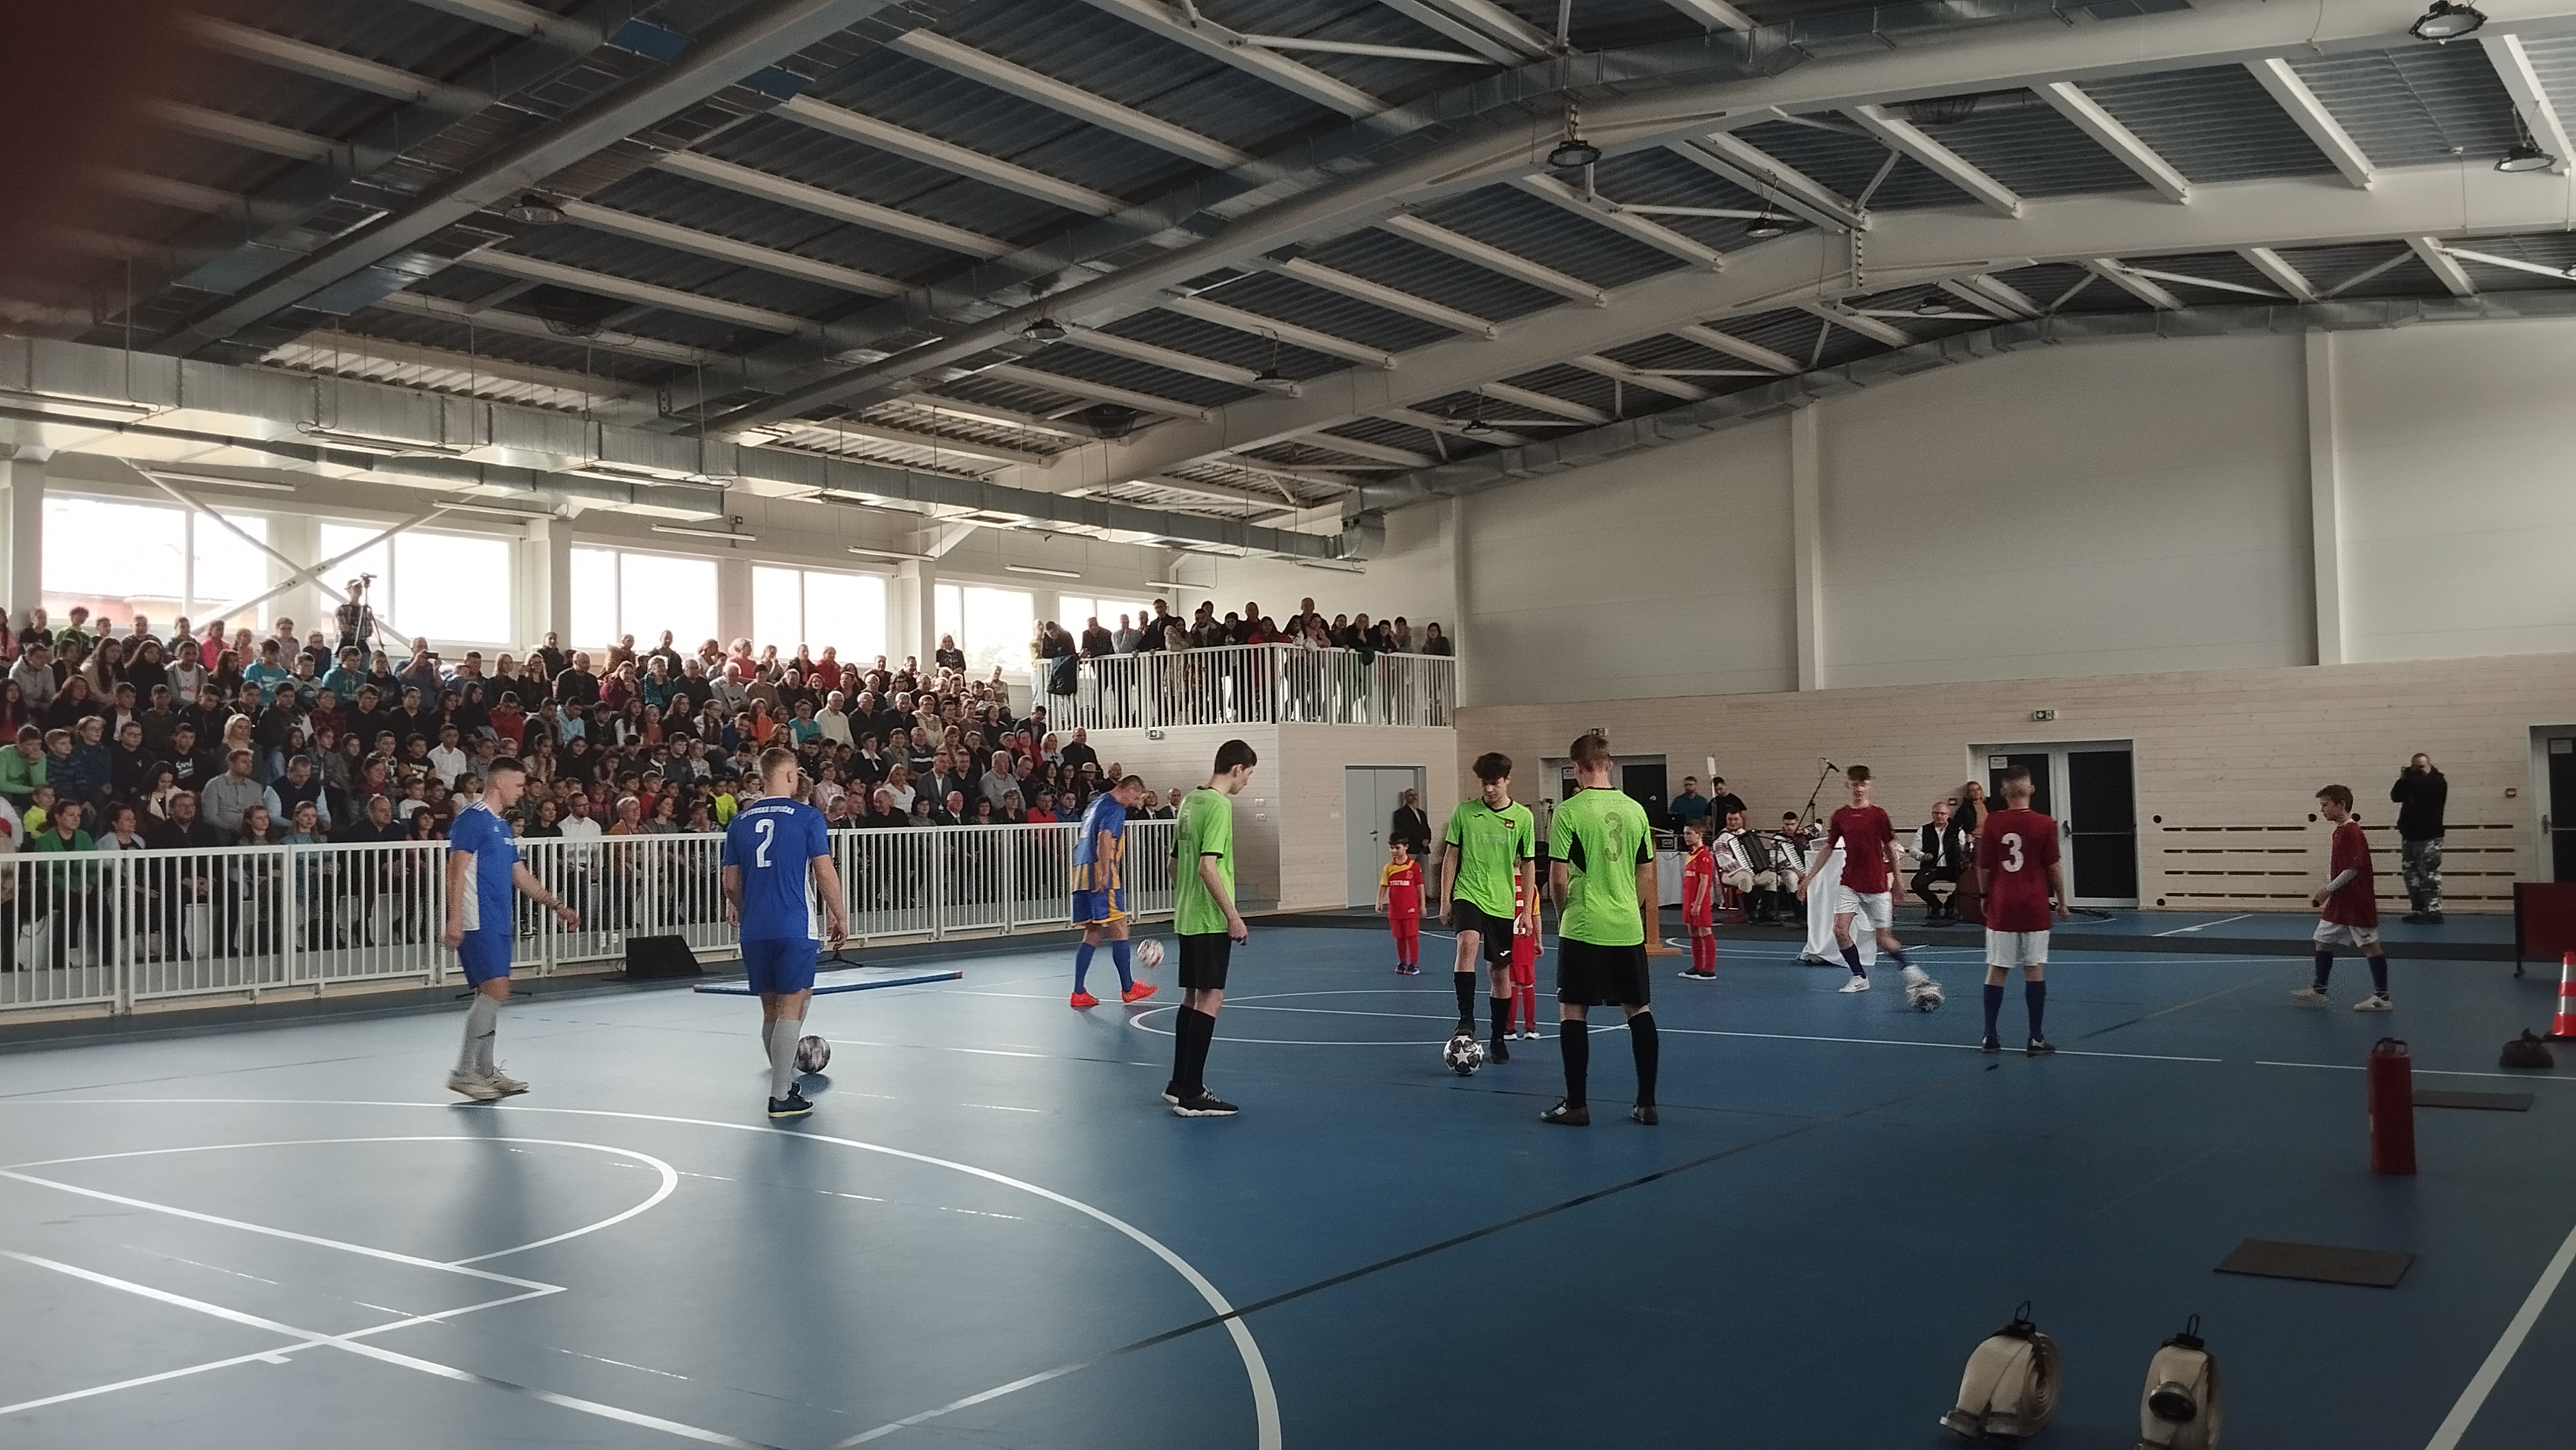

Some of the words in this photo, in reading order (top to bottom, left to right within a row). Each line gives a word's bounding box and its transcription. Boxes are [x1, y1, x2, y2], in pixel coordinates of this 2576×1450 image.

[754, 818, 775, 868] 2
[1604, 812, 1623, 862] 3
[2000, 832, 2024, 872] 3
